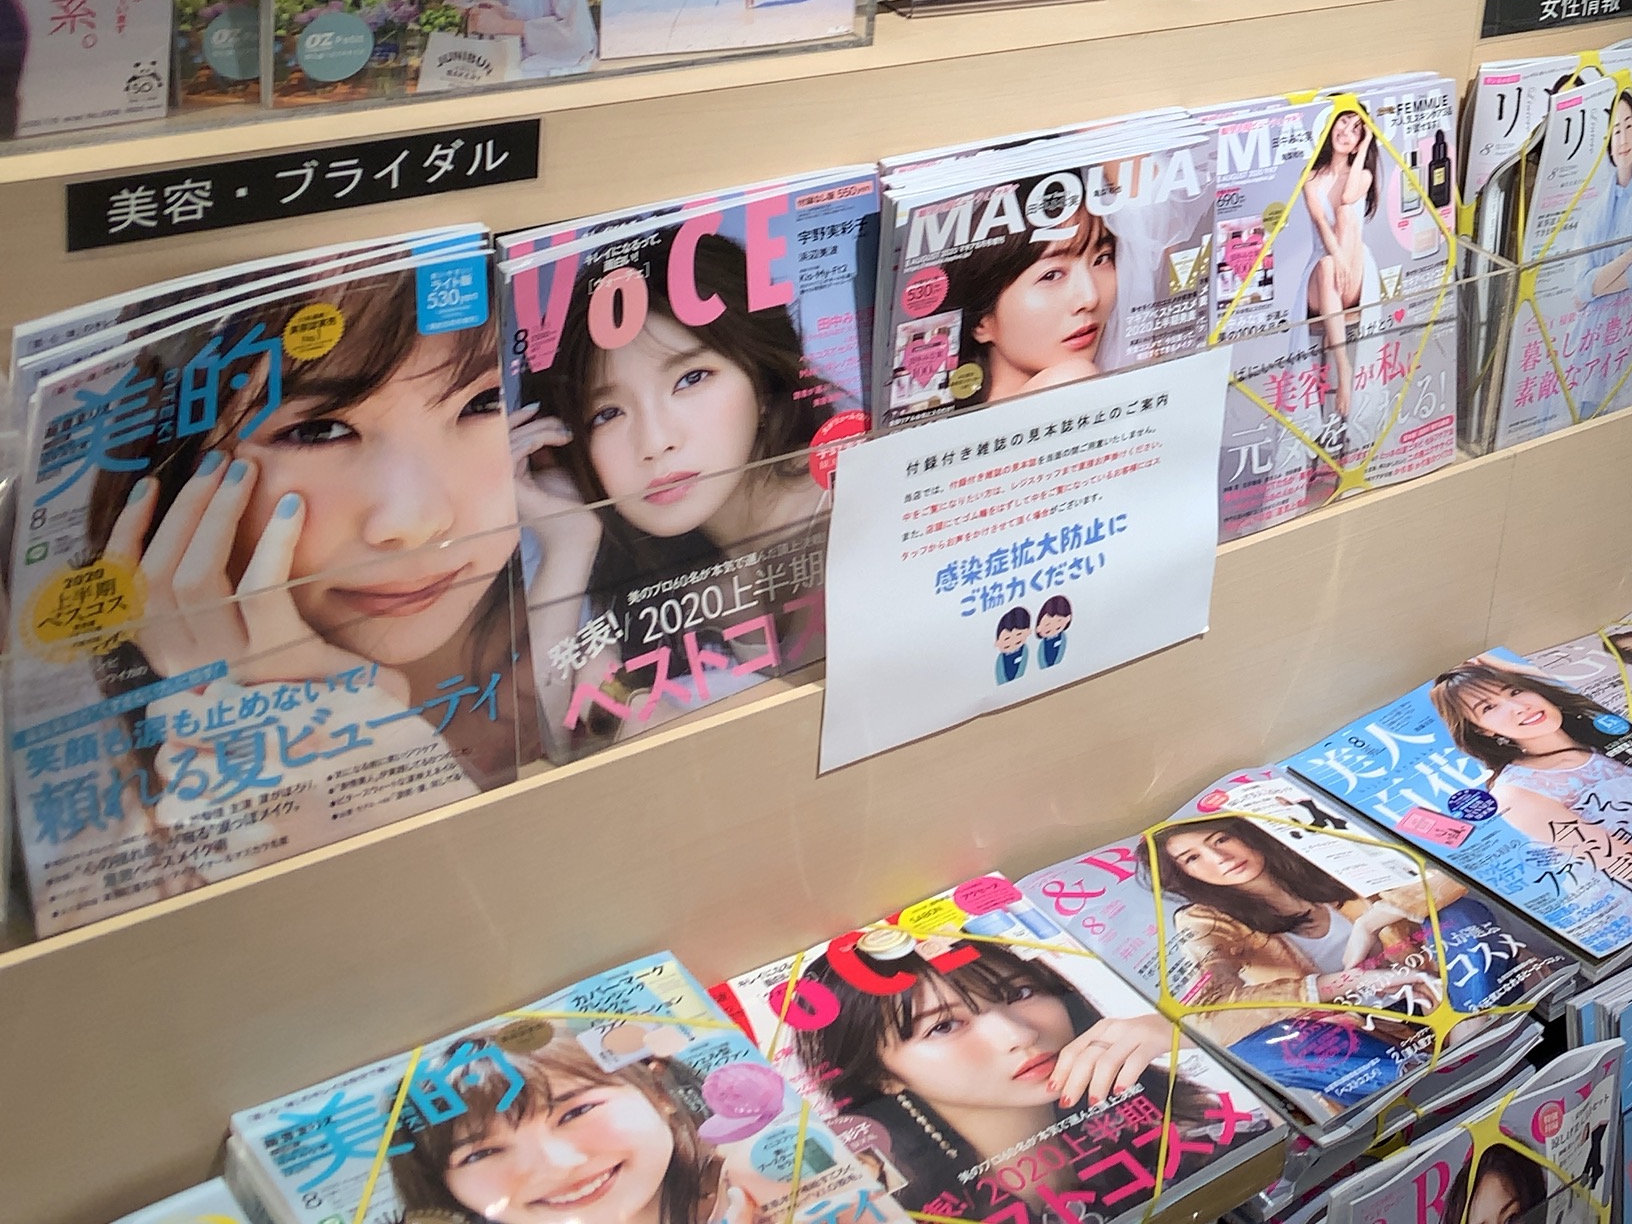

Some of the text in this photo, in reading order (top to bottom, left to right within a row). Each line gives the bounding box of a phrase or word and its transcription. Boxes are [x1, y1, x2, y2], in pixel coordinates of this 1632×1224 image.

[304, 32, 333, 49] OZ
[1396, 94, 1449, 116] FEMMUE
[107, 136, 509, 229] 美容・ブライダル
[905, 148, 1202, 260] MAQUIA
[796, 217, 870, 246] 宇野実彩子
[512, 328, 529, 355] 8
[34, 322, 282, 506] 美的
[1261, 363, 1333, 420] 美容
[905, 392, 1170, 477] 付録付き雑誌の見本誌休止のご案内
[30, 508, 47, 531] 8
[63, 568, 105, 589] 2020
[935, 513, 1128, 596] 感染症拡大防止に
[960, 552, 1106, 618] ご協力ください
[37, 595, 128, 629] ベスコス
[57, 579, 117, 609] 上半期
[638, 550, 824, 645] 2020上半期
[30, 672, 503, 846] 頼れる夏ビューティ
[1306, 722, 1437, 796] 美人
[1347, 736, 1366, 749] 8
[278, 1040, 526, 1193] 美的
[977, 1096, 1163, 1206] 2020上半期
